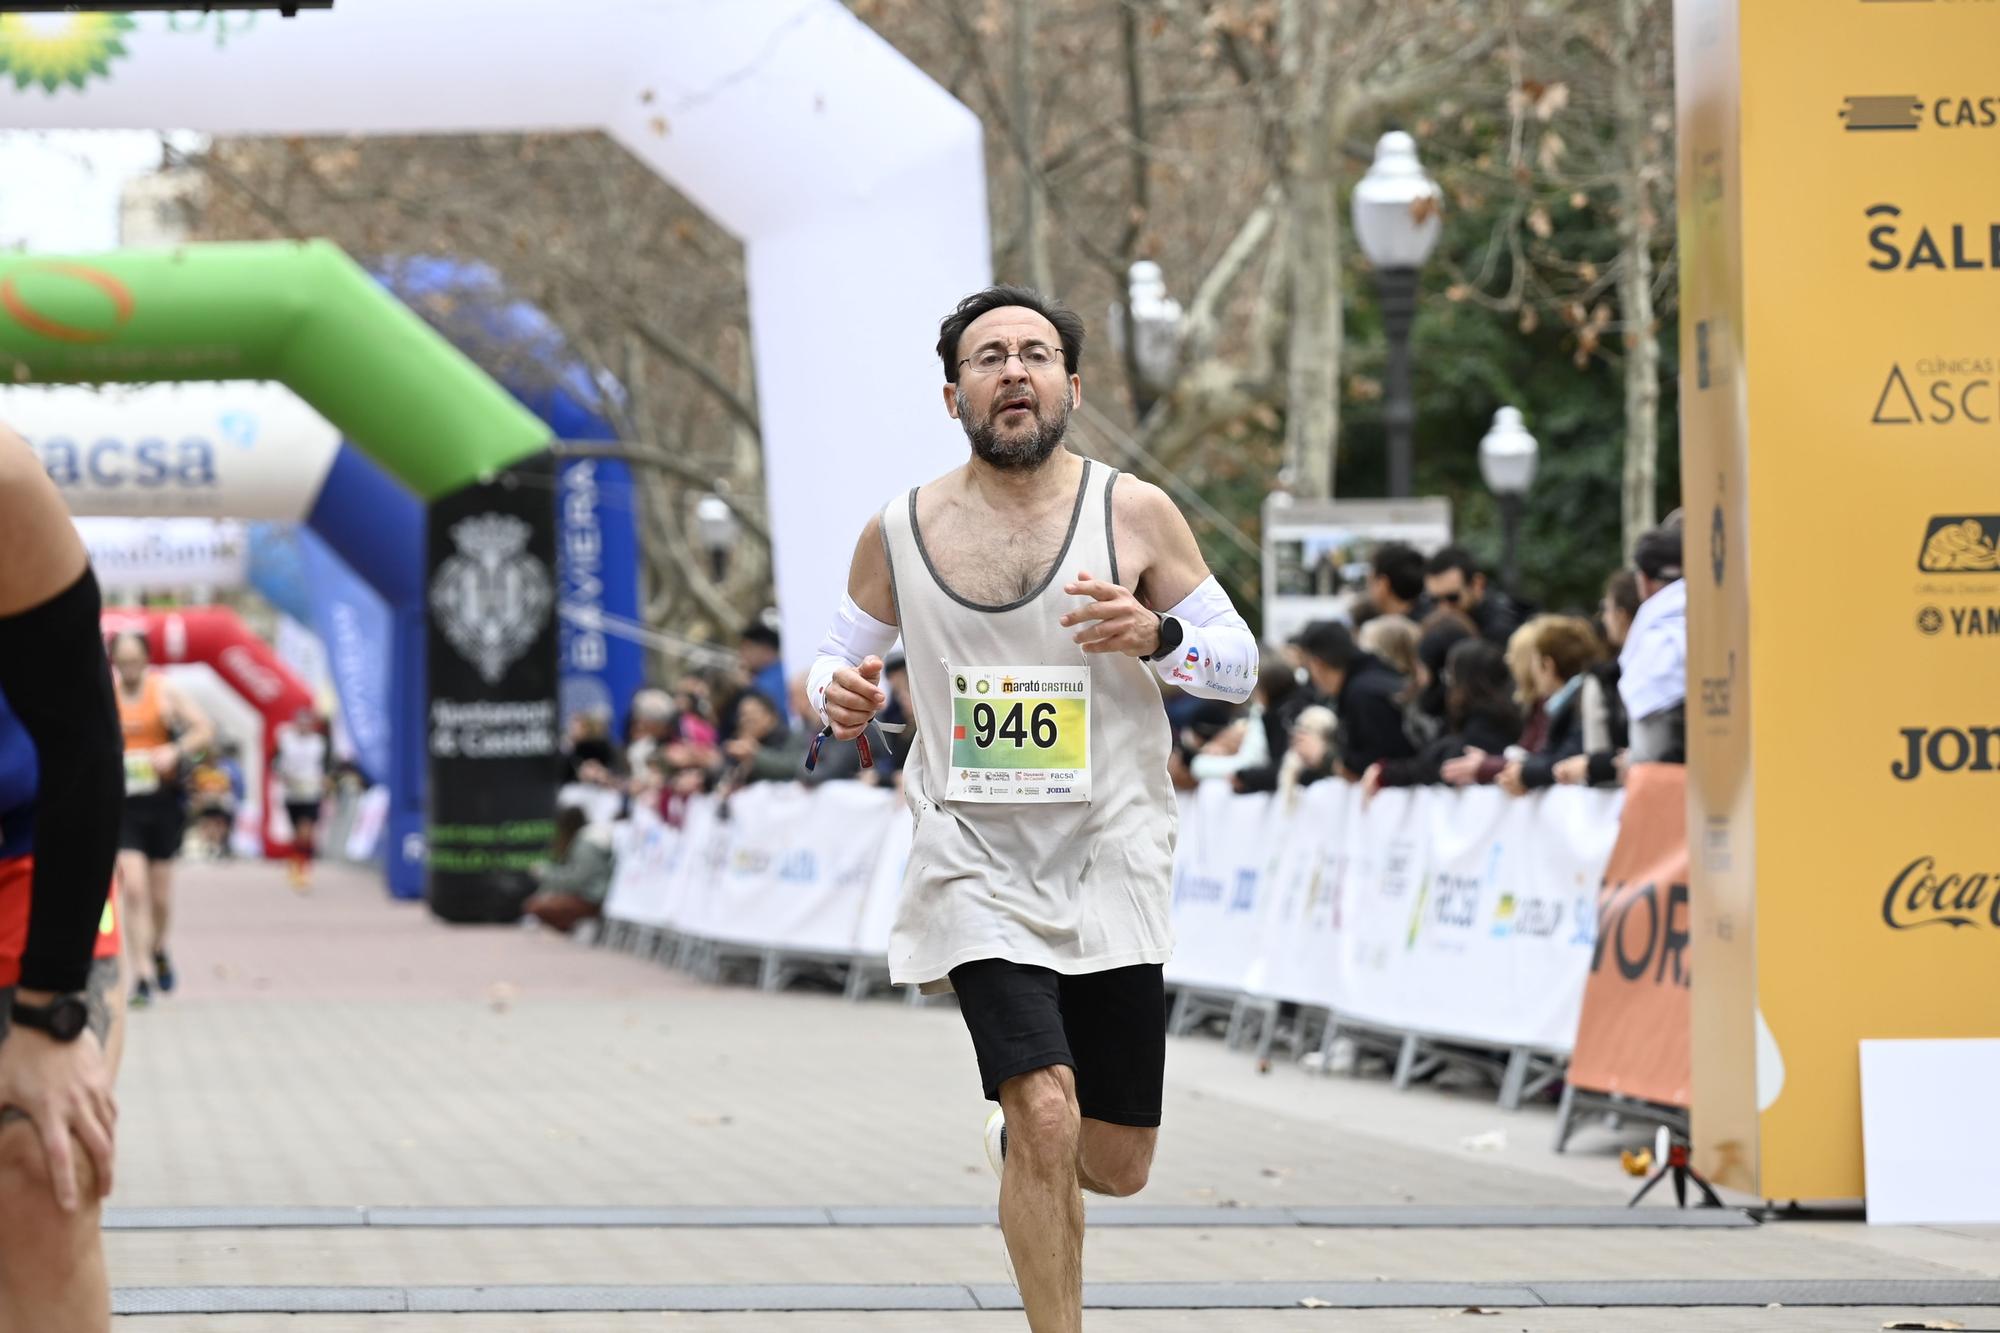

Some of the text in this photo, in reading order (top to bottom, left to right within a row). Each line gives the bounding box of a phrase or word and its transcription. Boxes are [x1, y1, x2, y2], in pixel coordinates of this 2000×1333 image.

[1934, 97, 2000, 127] CAS
[1871, 362, 2000, 424] ASC
[40, 435, 216, 487] acsa
[1002, 679, 1084, 693] marató CASTELLÓ
[973, 702, 1058, 749] 946
